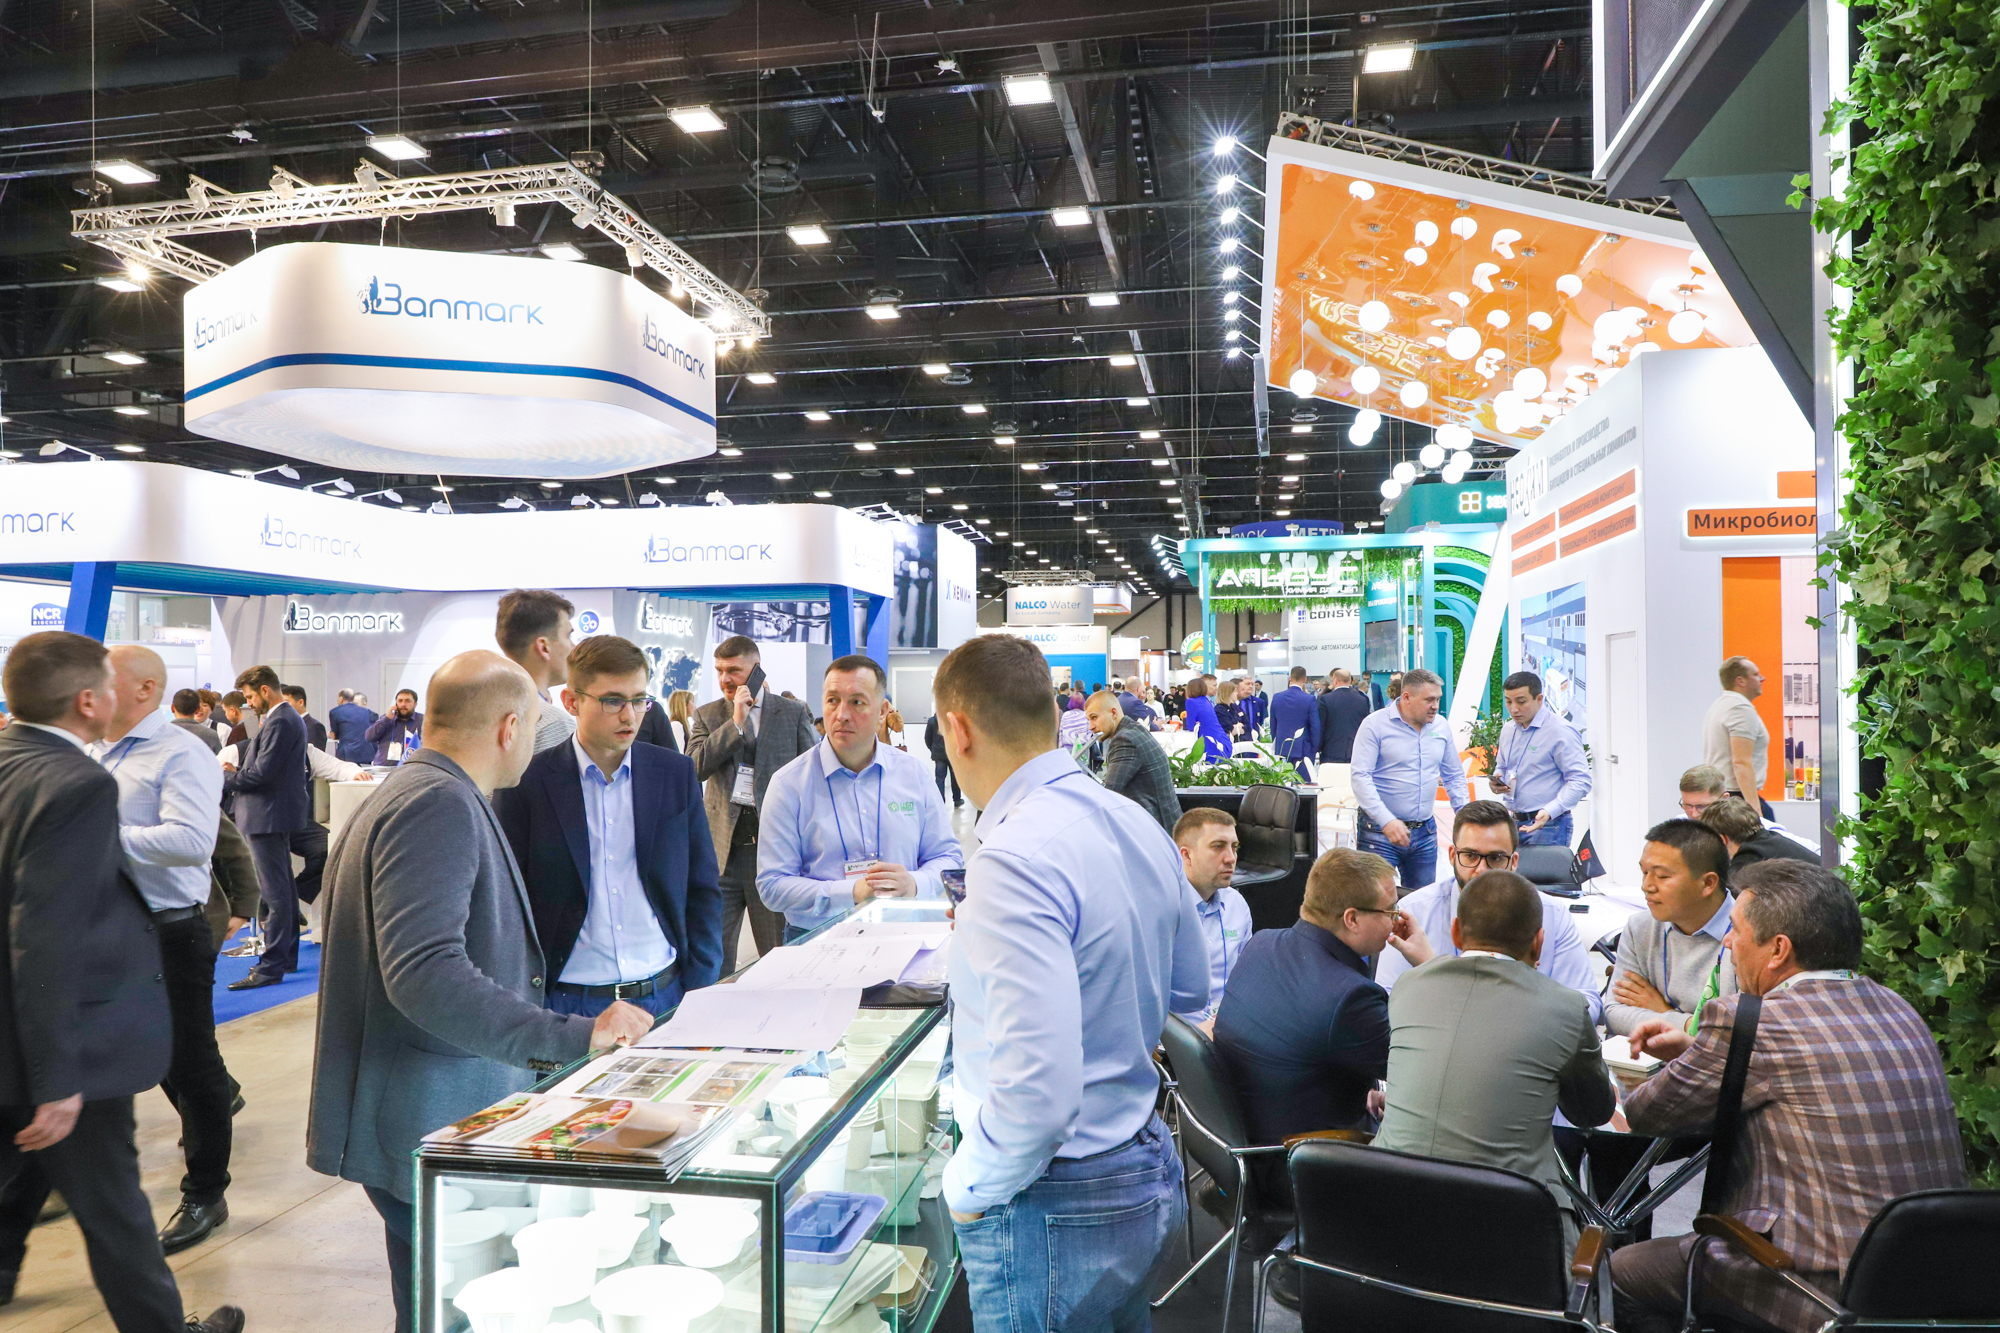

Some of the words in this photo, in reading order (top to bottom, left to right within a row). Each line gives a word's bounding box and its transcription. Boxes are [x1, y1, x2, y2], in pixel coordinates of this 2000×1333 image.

[371, 283, 544, 325] Banmark
[195, 310, 257, 350] Banmark
[646, 321, 705, 380] Banmark
[264, 517, 362, 559] Banmark
[649, 537, 772, 563] Banmark
[33, 607, 61, 620] NCR
[1015, 600, 1048, 610] NALCO
[1049, 600, 1081, 609] Water
[1309, 608, 1360, 620] CONSYS
[291, 607, 400, 631] Banmark
